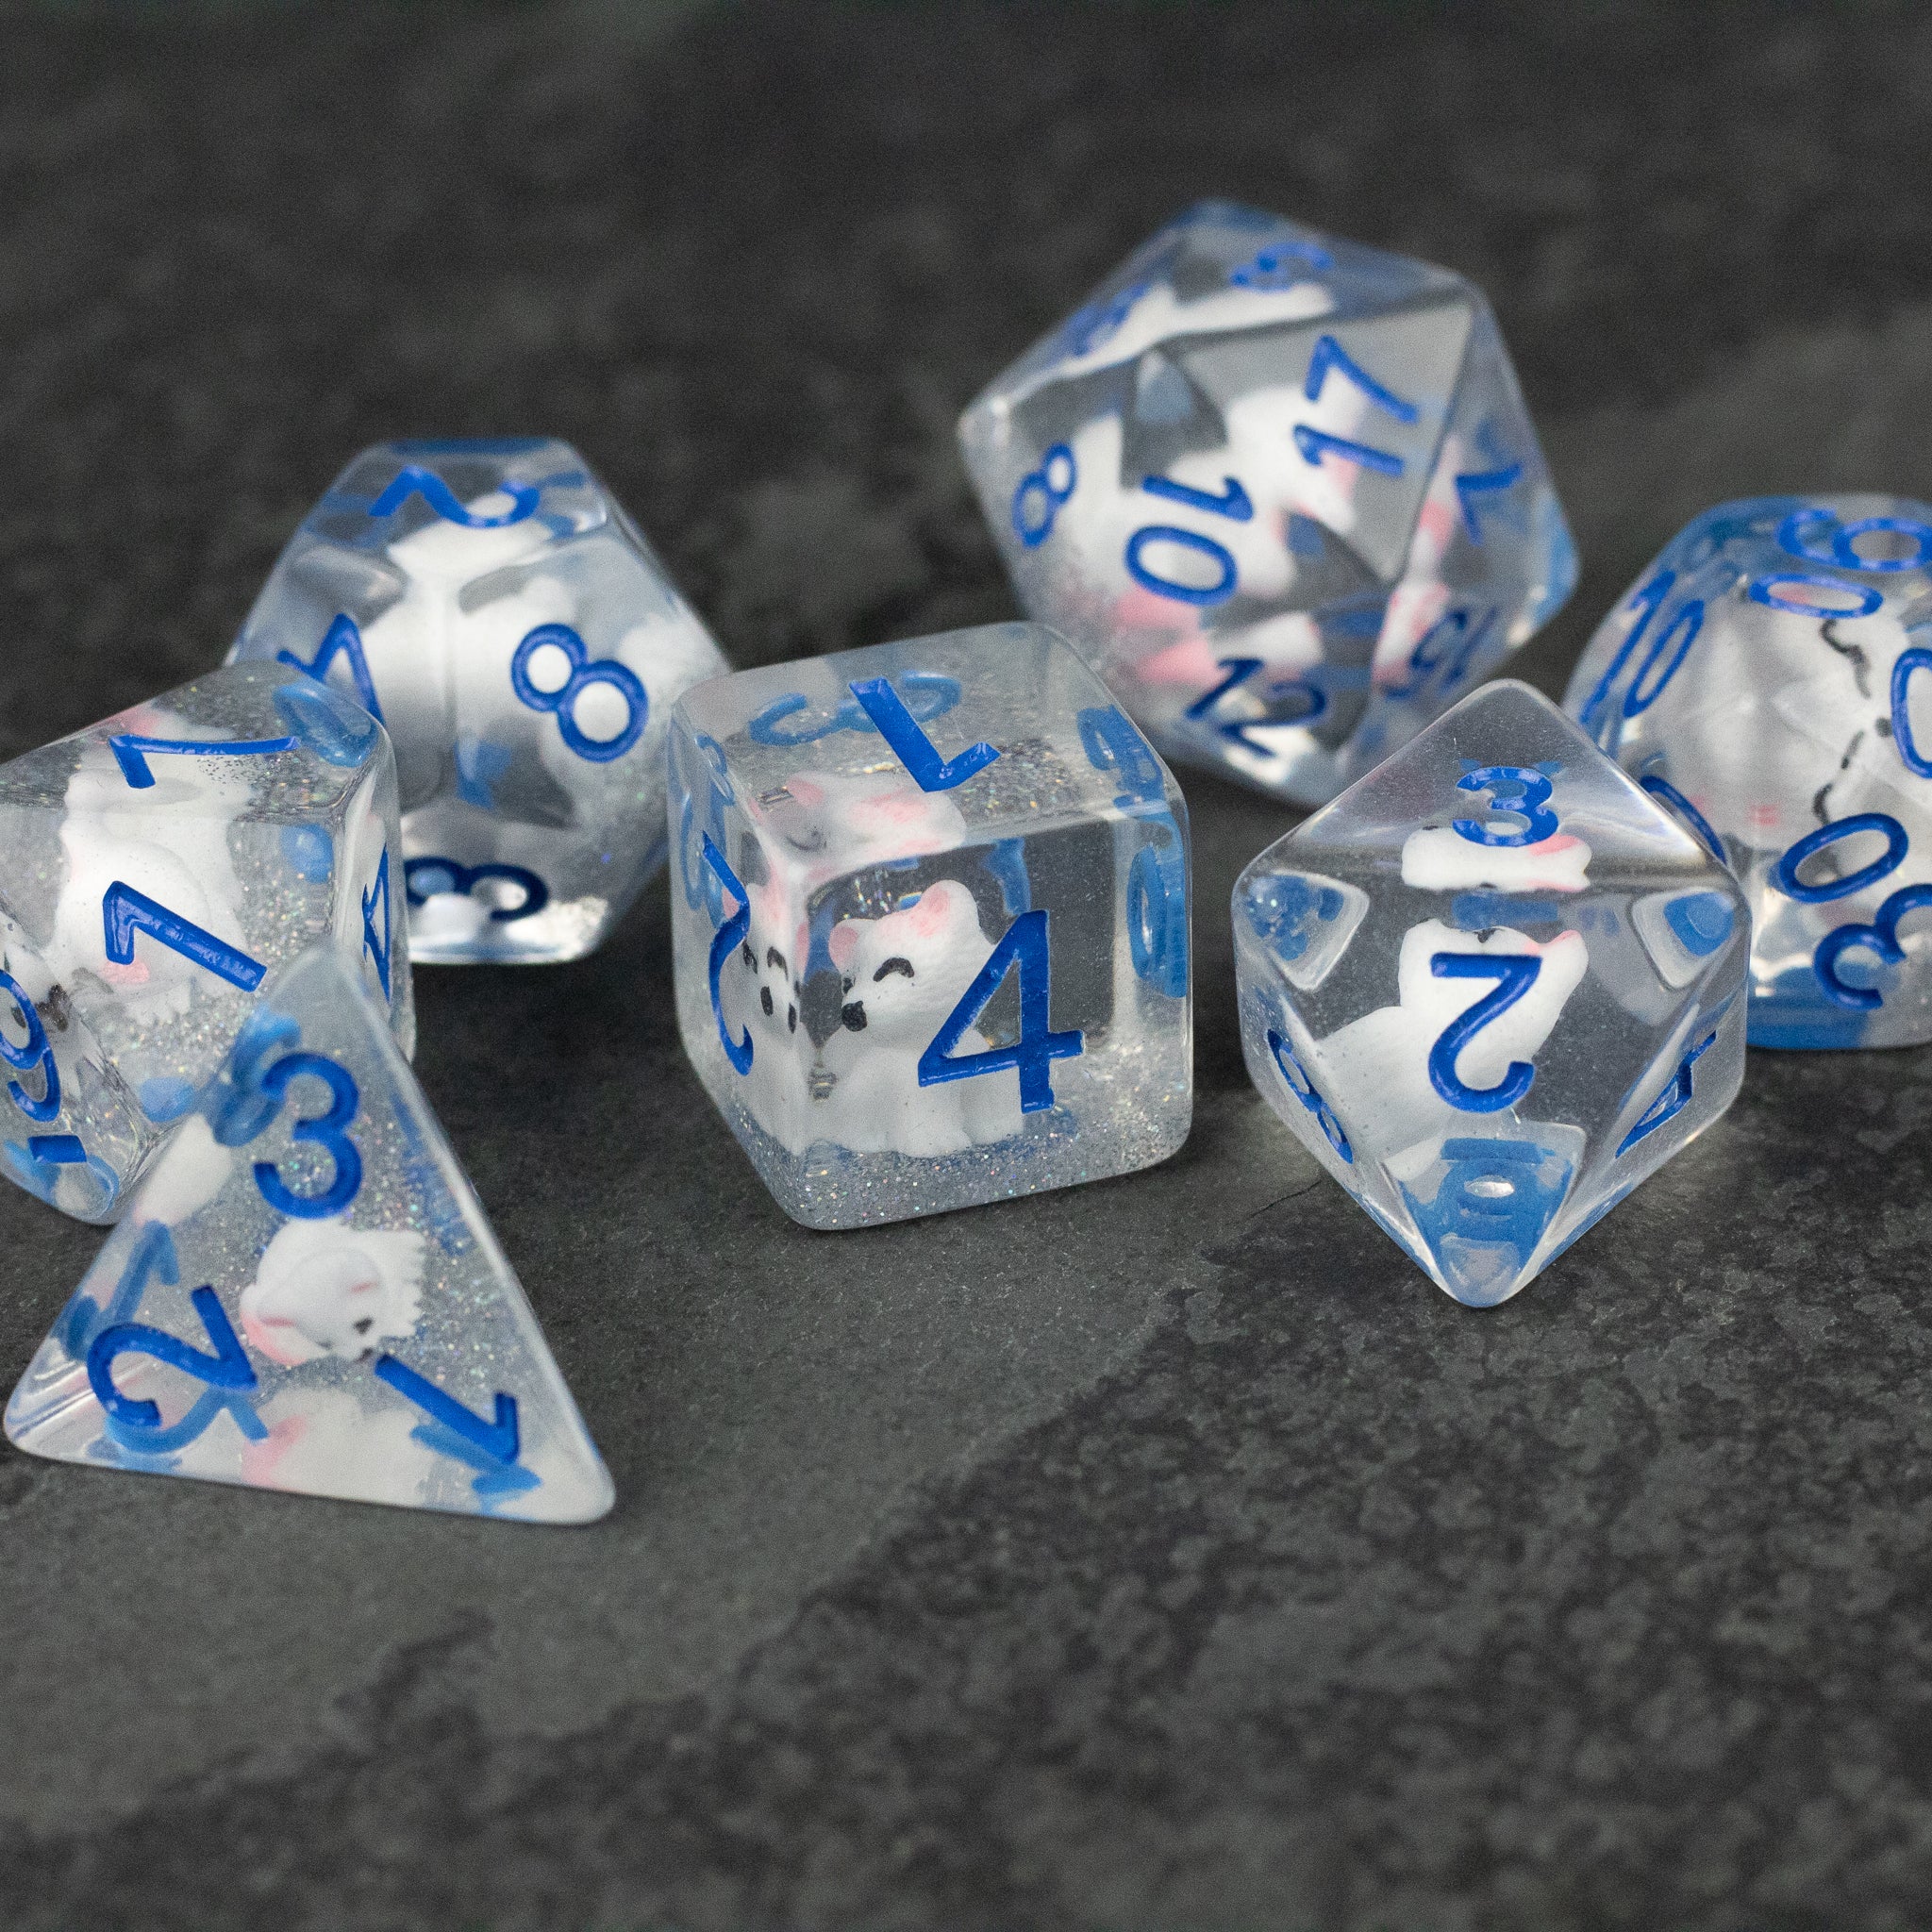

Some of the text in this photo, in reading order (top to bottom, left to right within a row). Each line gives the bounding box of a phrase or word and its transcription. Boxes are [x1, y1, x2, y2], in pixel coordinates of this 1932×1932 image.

[1291, 334, 1418, 474] 17
[1012, 441, 1078, 547] 8
[1124, 474, 1255, 606] 10
[510, 623, 650, 764] 8
[851, 675, 1002, 793] 1
[1452, 766, 1559, 847] 3
[701, 830, 753, 1075] 2
[1778, 812, 1932, 1012] 30
[918, 909, 1084, 1114] 4
[1427, 952, 1543, 1113] 2
[253, 1052, 362, 1219] 3
[1266, 1028, 1354, 1165] 8
[1615, 1029, 1717, 1159] 4
[86, 1285, 258, 1428] 2
[375, 1352, 519, 1464] 1
